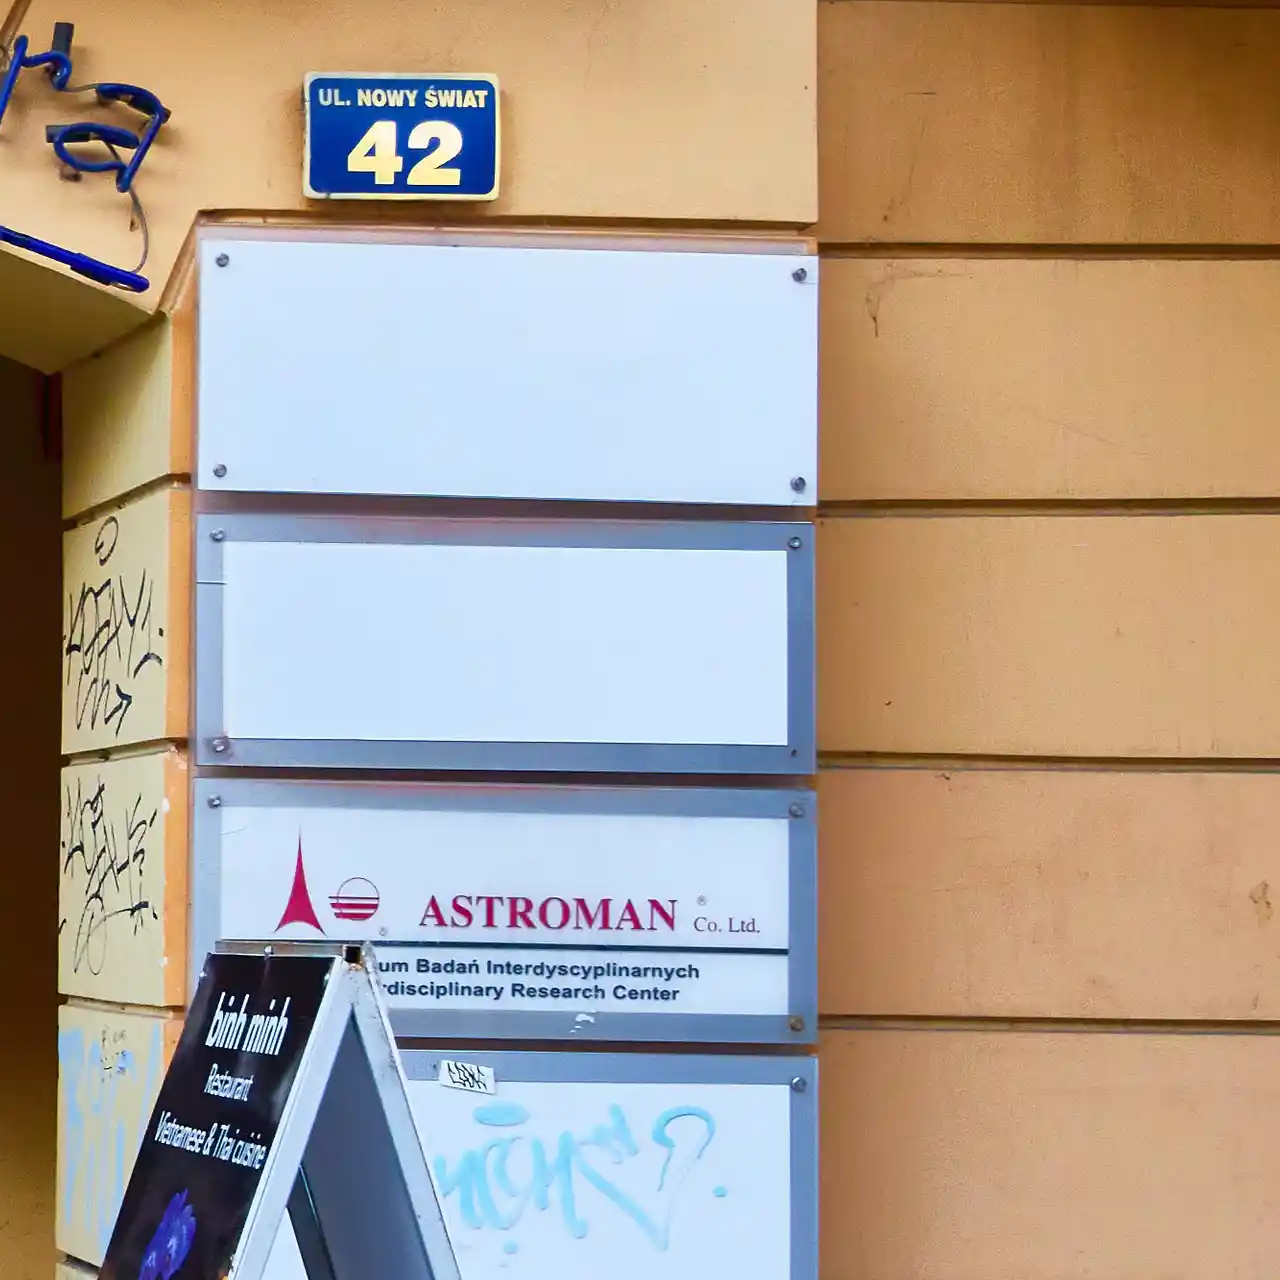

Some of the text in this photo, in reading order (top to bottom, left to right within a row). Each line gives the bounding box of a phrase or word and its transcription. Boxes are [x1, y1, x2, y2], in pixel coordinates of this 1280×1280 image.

[318, 85, 489, 108] UL. NOWY ŚWIAT
[347, 119, 463, 186] 42
[418, 894, 761, 934] ASTROMAN Co. Ltd.
[416, 957, 480, 975] Badań
[486, 959, 701, 981] Interdyscyplinarnych
[511, 982, 606, 1001] Research
[612, 984, 681, 1001] Center
[205, 991, 291, 1056] binh minh
[204, 1063, 255, 1102] Restaurant
[154, 1110, 207, 1154] Vietnamese
[213, 1123, 241, 1161] Thai
[231, 1130, 268, 1170] cuisine
